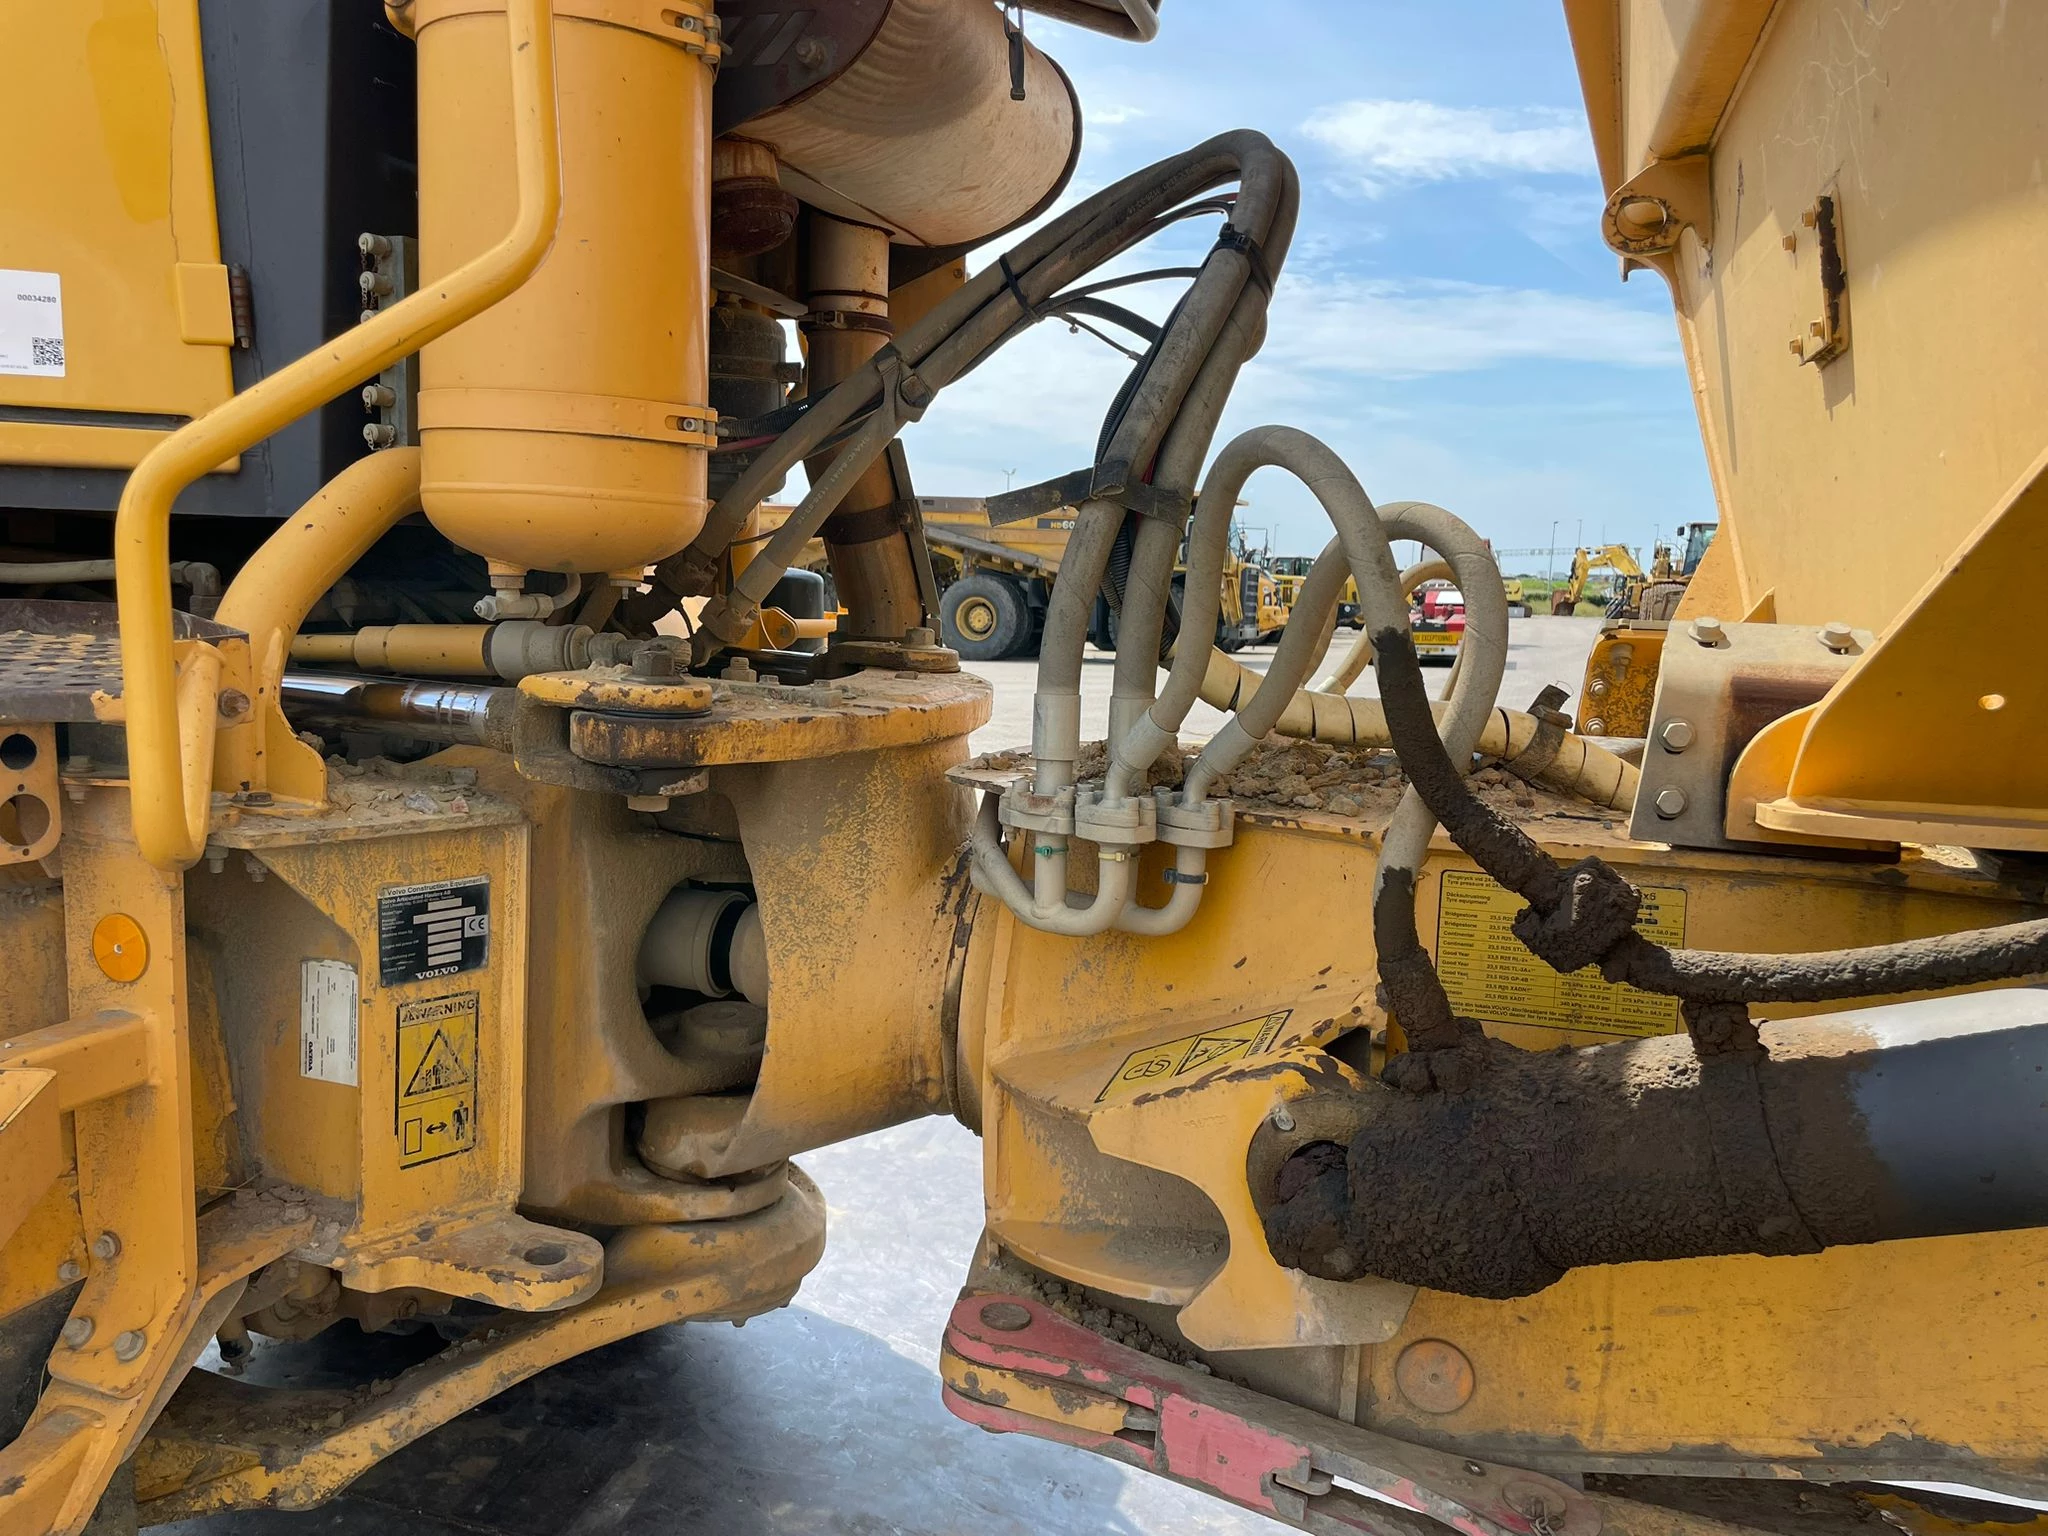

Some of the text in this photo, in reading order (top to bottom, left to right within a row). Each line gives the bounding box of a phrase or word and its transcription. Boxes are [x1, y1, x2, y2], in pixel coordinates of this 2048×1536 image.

[17, 293, 57, 304] 00034280
[1050, 520, 1075, 530] HD60
[387, 877, 482, 896] Volvo Construction Equipment
[397, 894, 423, 902] Articulated
[469, 918, 484, 931] CE
[1445, 921, 1477, 929] Bridgestone
[416, 965, 458, 980] VOLVO
